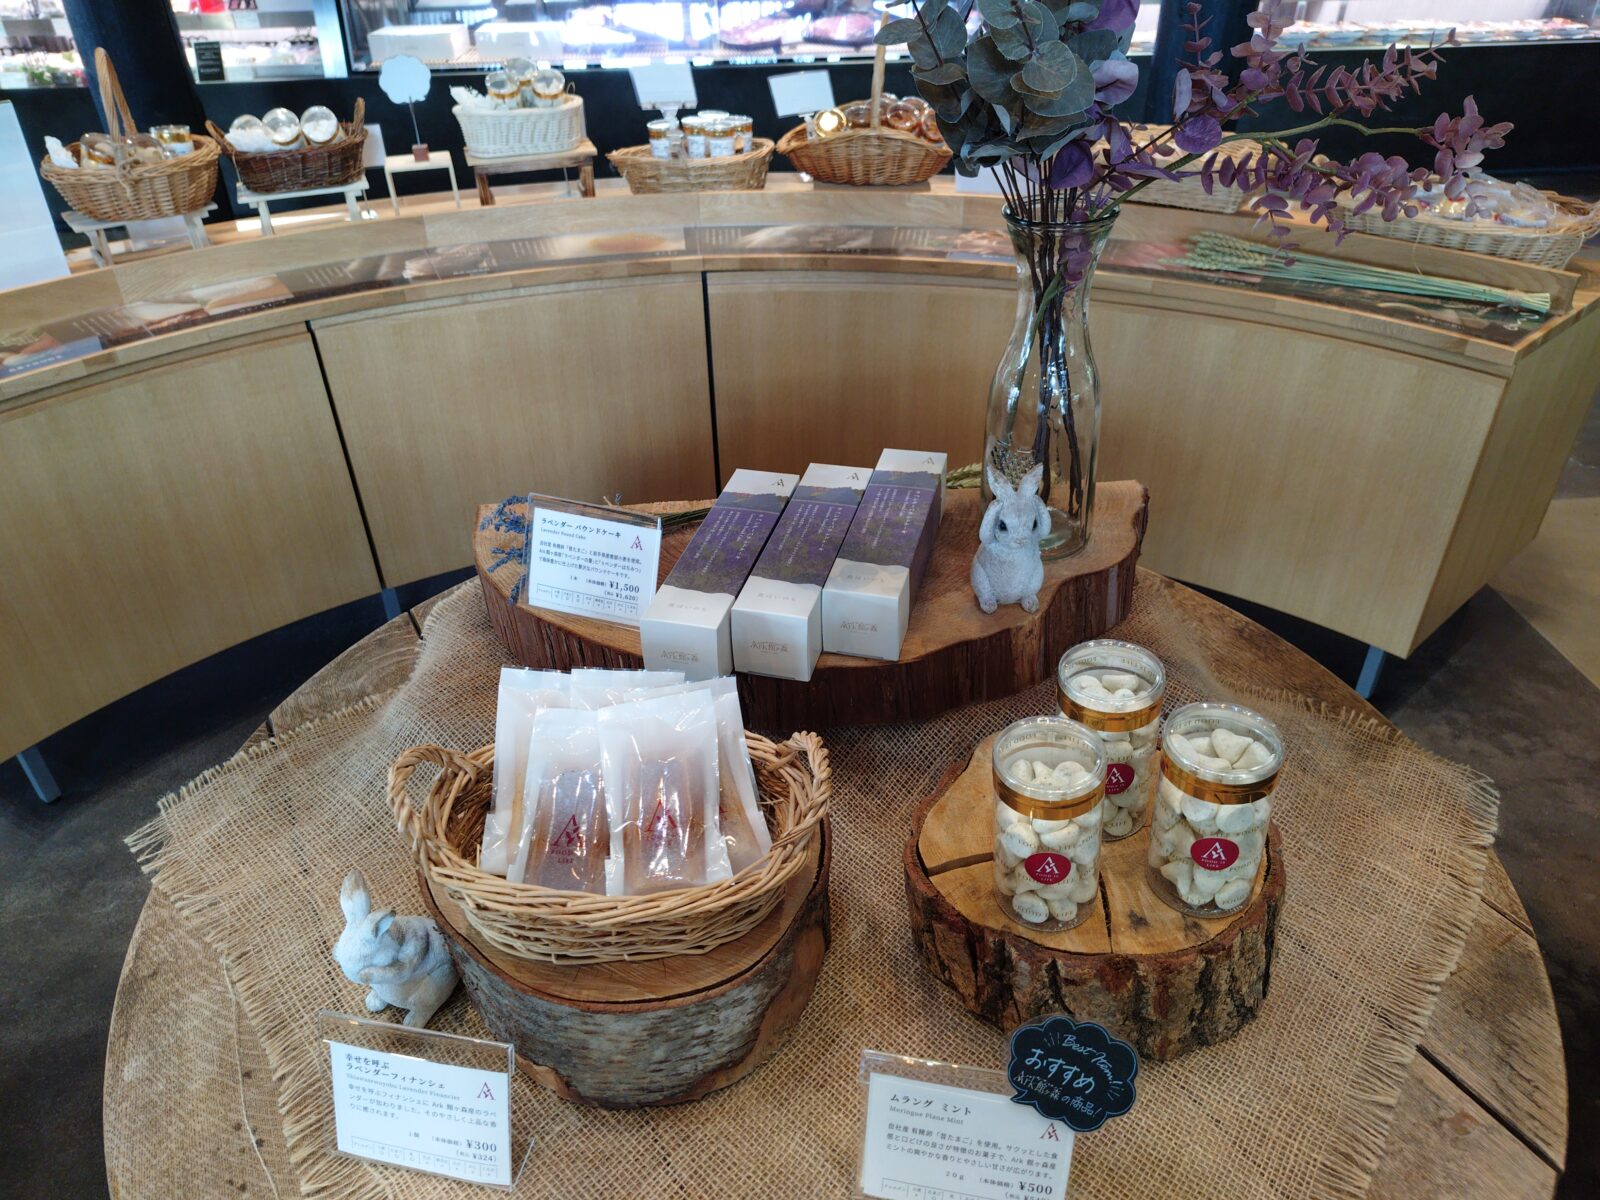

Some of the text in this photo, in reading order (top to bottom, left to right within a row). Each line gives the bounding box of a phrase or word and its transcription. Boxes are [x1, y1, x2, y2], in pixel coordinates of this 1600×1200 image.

[541, 517, 621, 538] ラベンダー パウンドケーキ
[609, 580, 640, 594] ¥1,500
[1062, 1034, 1096, 1055] Best
[346, 1053, 390, 1070] 幸せを呼ぶ
[1024, 1048, 1095, 1094] おすすめ
[346, 1063, 446, 1089] ラベンダーフィナンシェ
[890, 1094, 972, 1116] ムラング ミント
[890, 1106, 964, 1125] Meringue Plane Mint
[888, 1123, 909, 1134] 自社産
[466, 1139, 497, 1153] ¥300
[886, 1143, 1053, 1180] ミントの爽やかな香りとやさしい甘さが広がります。
[1011, 1156, 1024, 1165] Ark
[1018, 1181, 1053, 1196] ¥500
